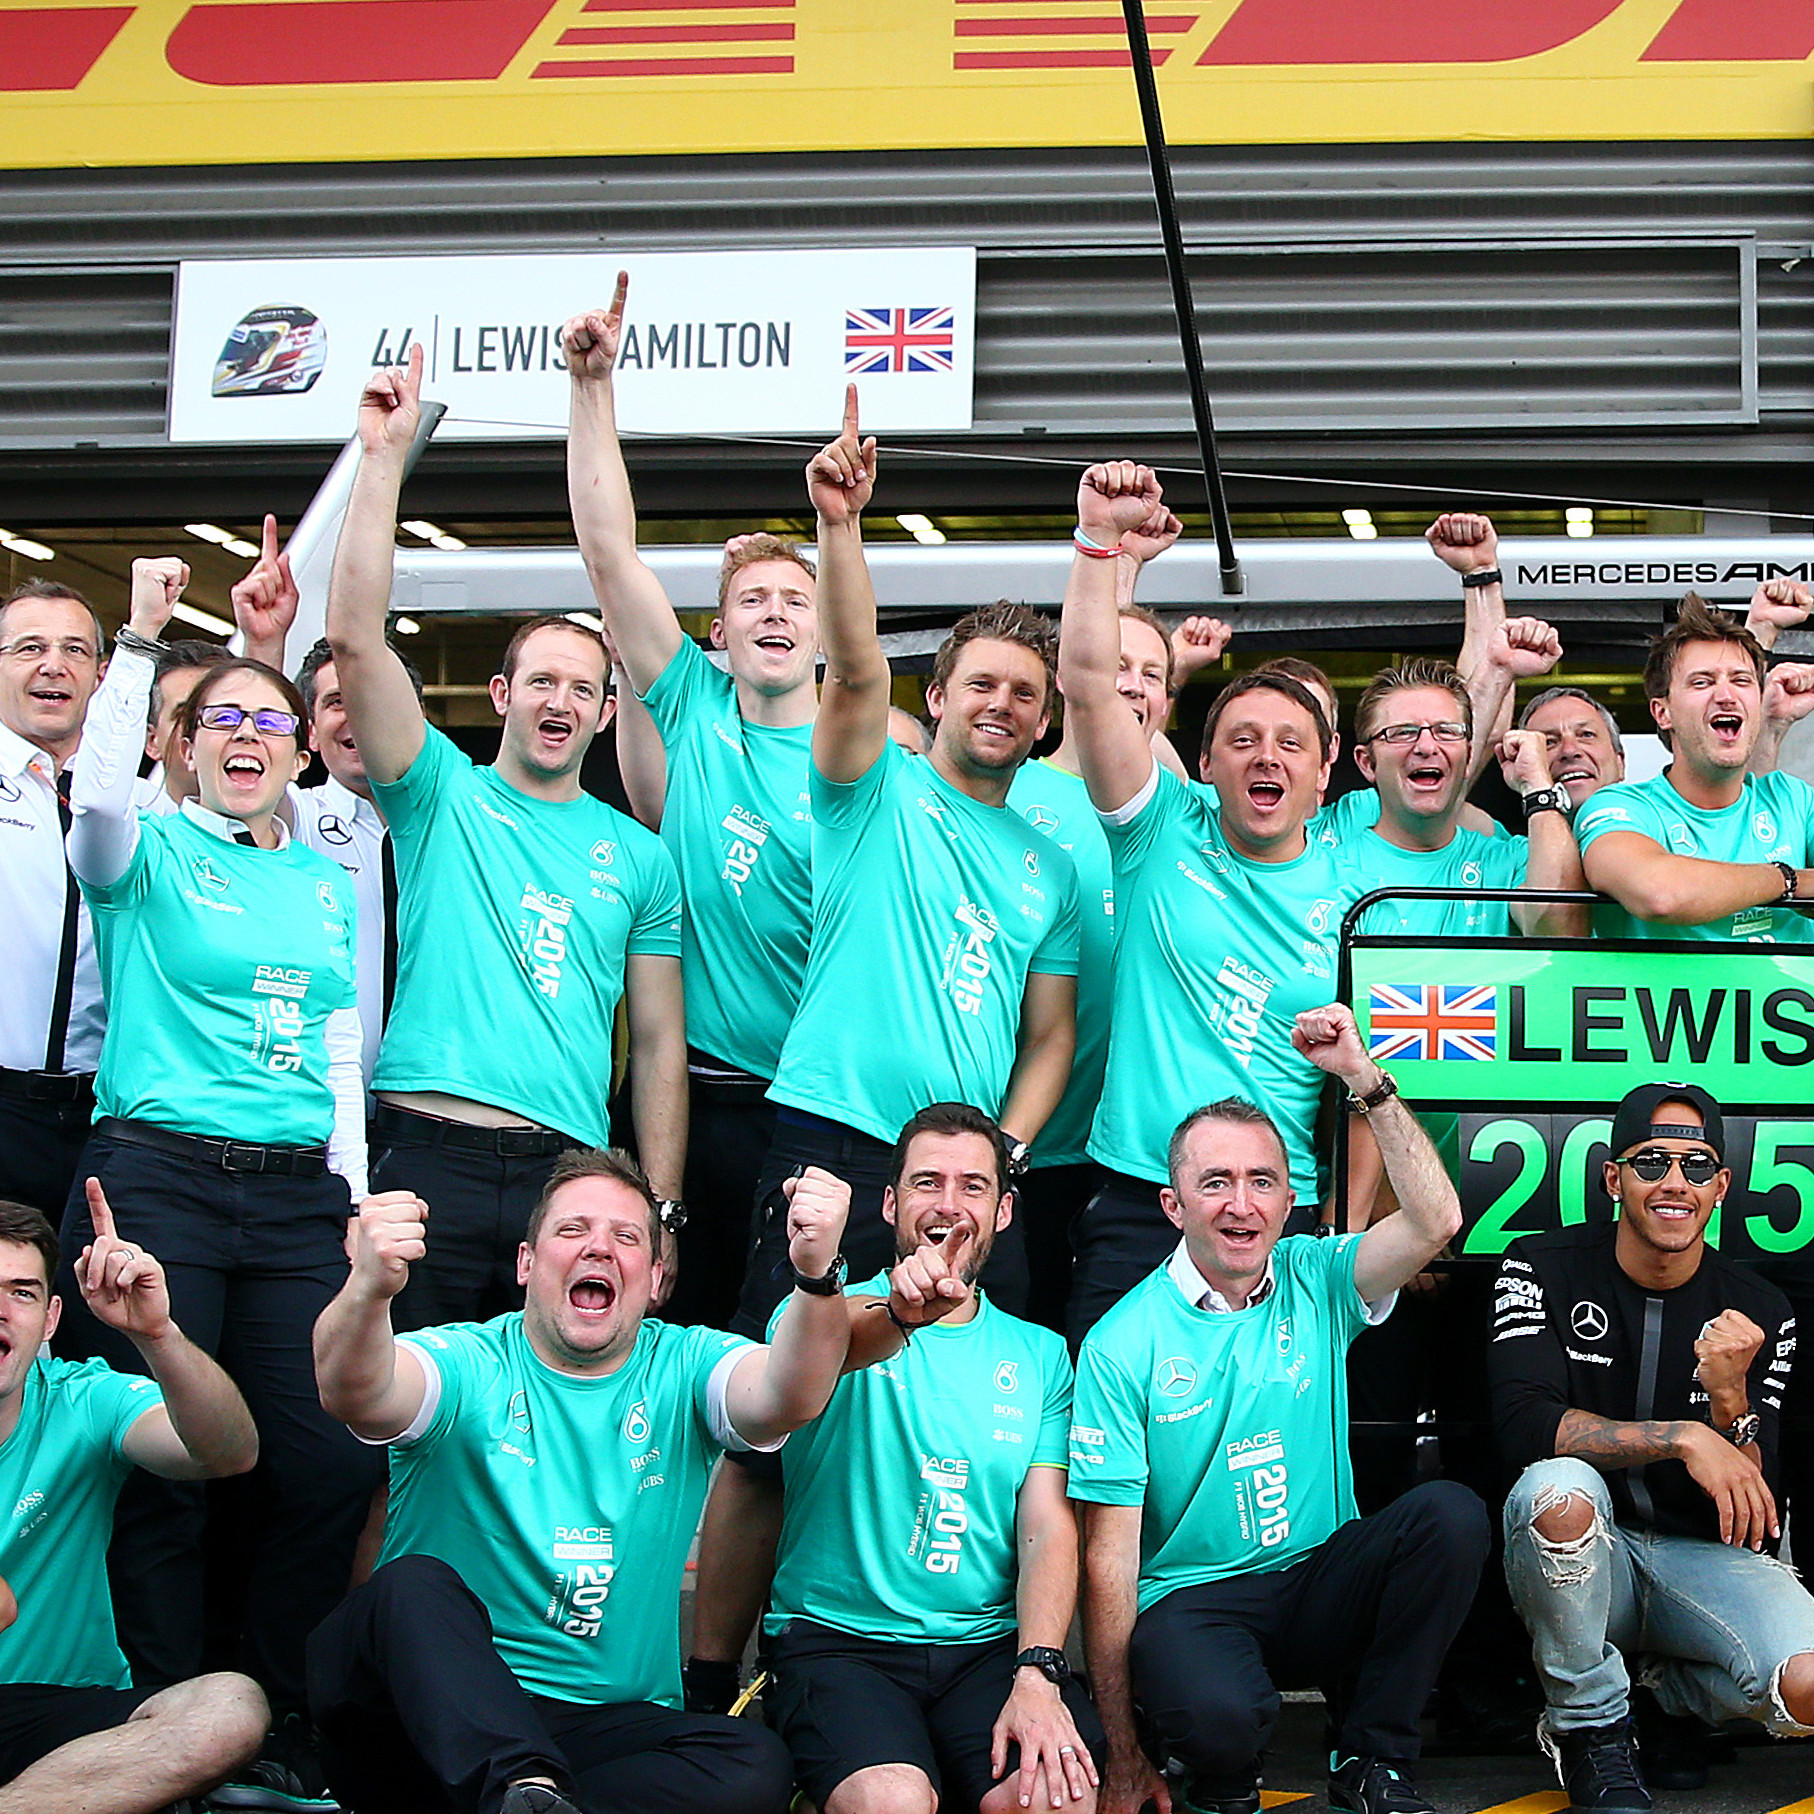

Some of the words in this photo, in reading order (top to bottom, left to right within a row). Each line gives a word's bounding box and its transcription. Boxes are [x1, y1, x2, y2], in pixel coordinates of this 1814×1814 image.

[371, 327, 413, 367] 44
[617, 321, 791, 370] AMILTON
[730, 804, 772, 834] RACE
[725, 839, 759, 886] 20
[589, 869, 621, 886] BOSS
[524, 882, 576, 913] RACE
[1733, 906, 1774, 923] RACE
[531, 917, 567, 999] 2015
[255, 965, 313, 985] RACE
[1222, 955, 1276, 992] RACE
[254, 980, 307, 997] WINNER
[268, 997, 304, 1073] 2015
[1223, 994, 1265, 1069] 201
[1494, 1276, 1544, 1301] EPSON
[1569, 1349, 1614, 1367] BlackBerry
[992, 1403, 1025, 1419] BOSS
[1166, 1397, 1214, 1423] BlackBerry
[1005, 1431, 1024, 1444] UBS
[1226, 1429, 1283, 1457] RACE
[629, 1446, 661, 1471] BOSS
[1229, 1447, 1283, 1469] WINNER
[642, 1473, 665, 1489] UBS
[1253, 1464, 1291, 1548] 2015
[554, 1526, 613, 1542] RACE
[925, 1489, 968, 1574] 2015
[554, 1545, 612, 1558] WINNER
[563, 1564, 615, 1637] 2015
